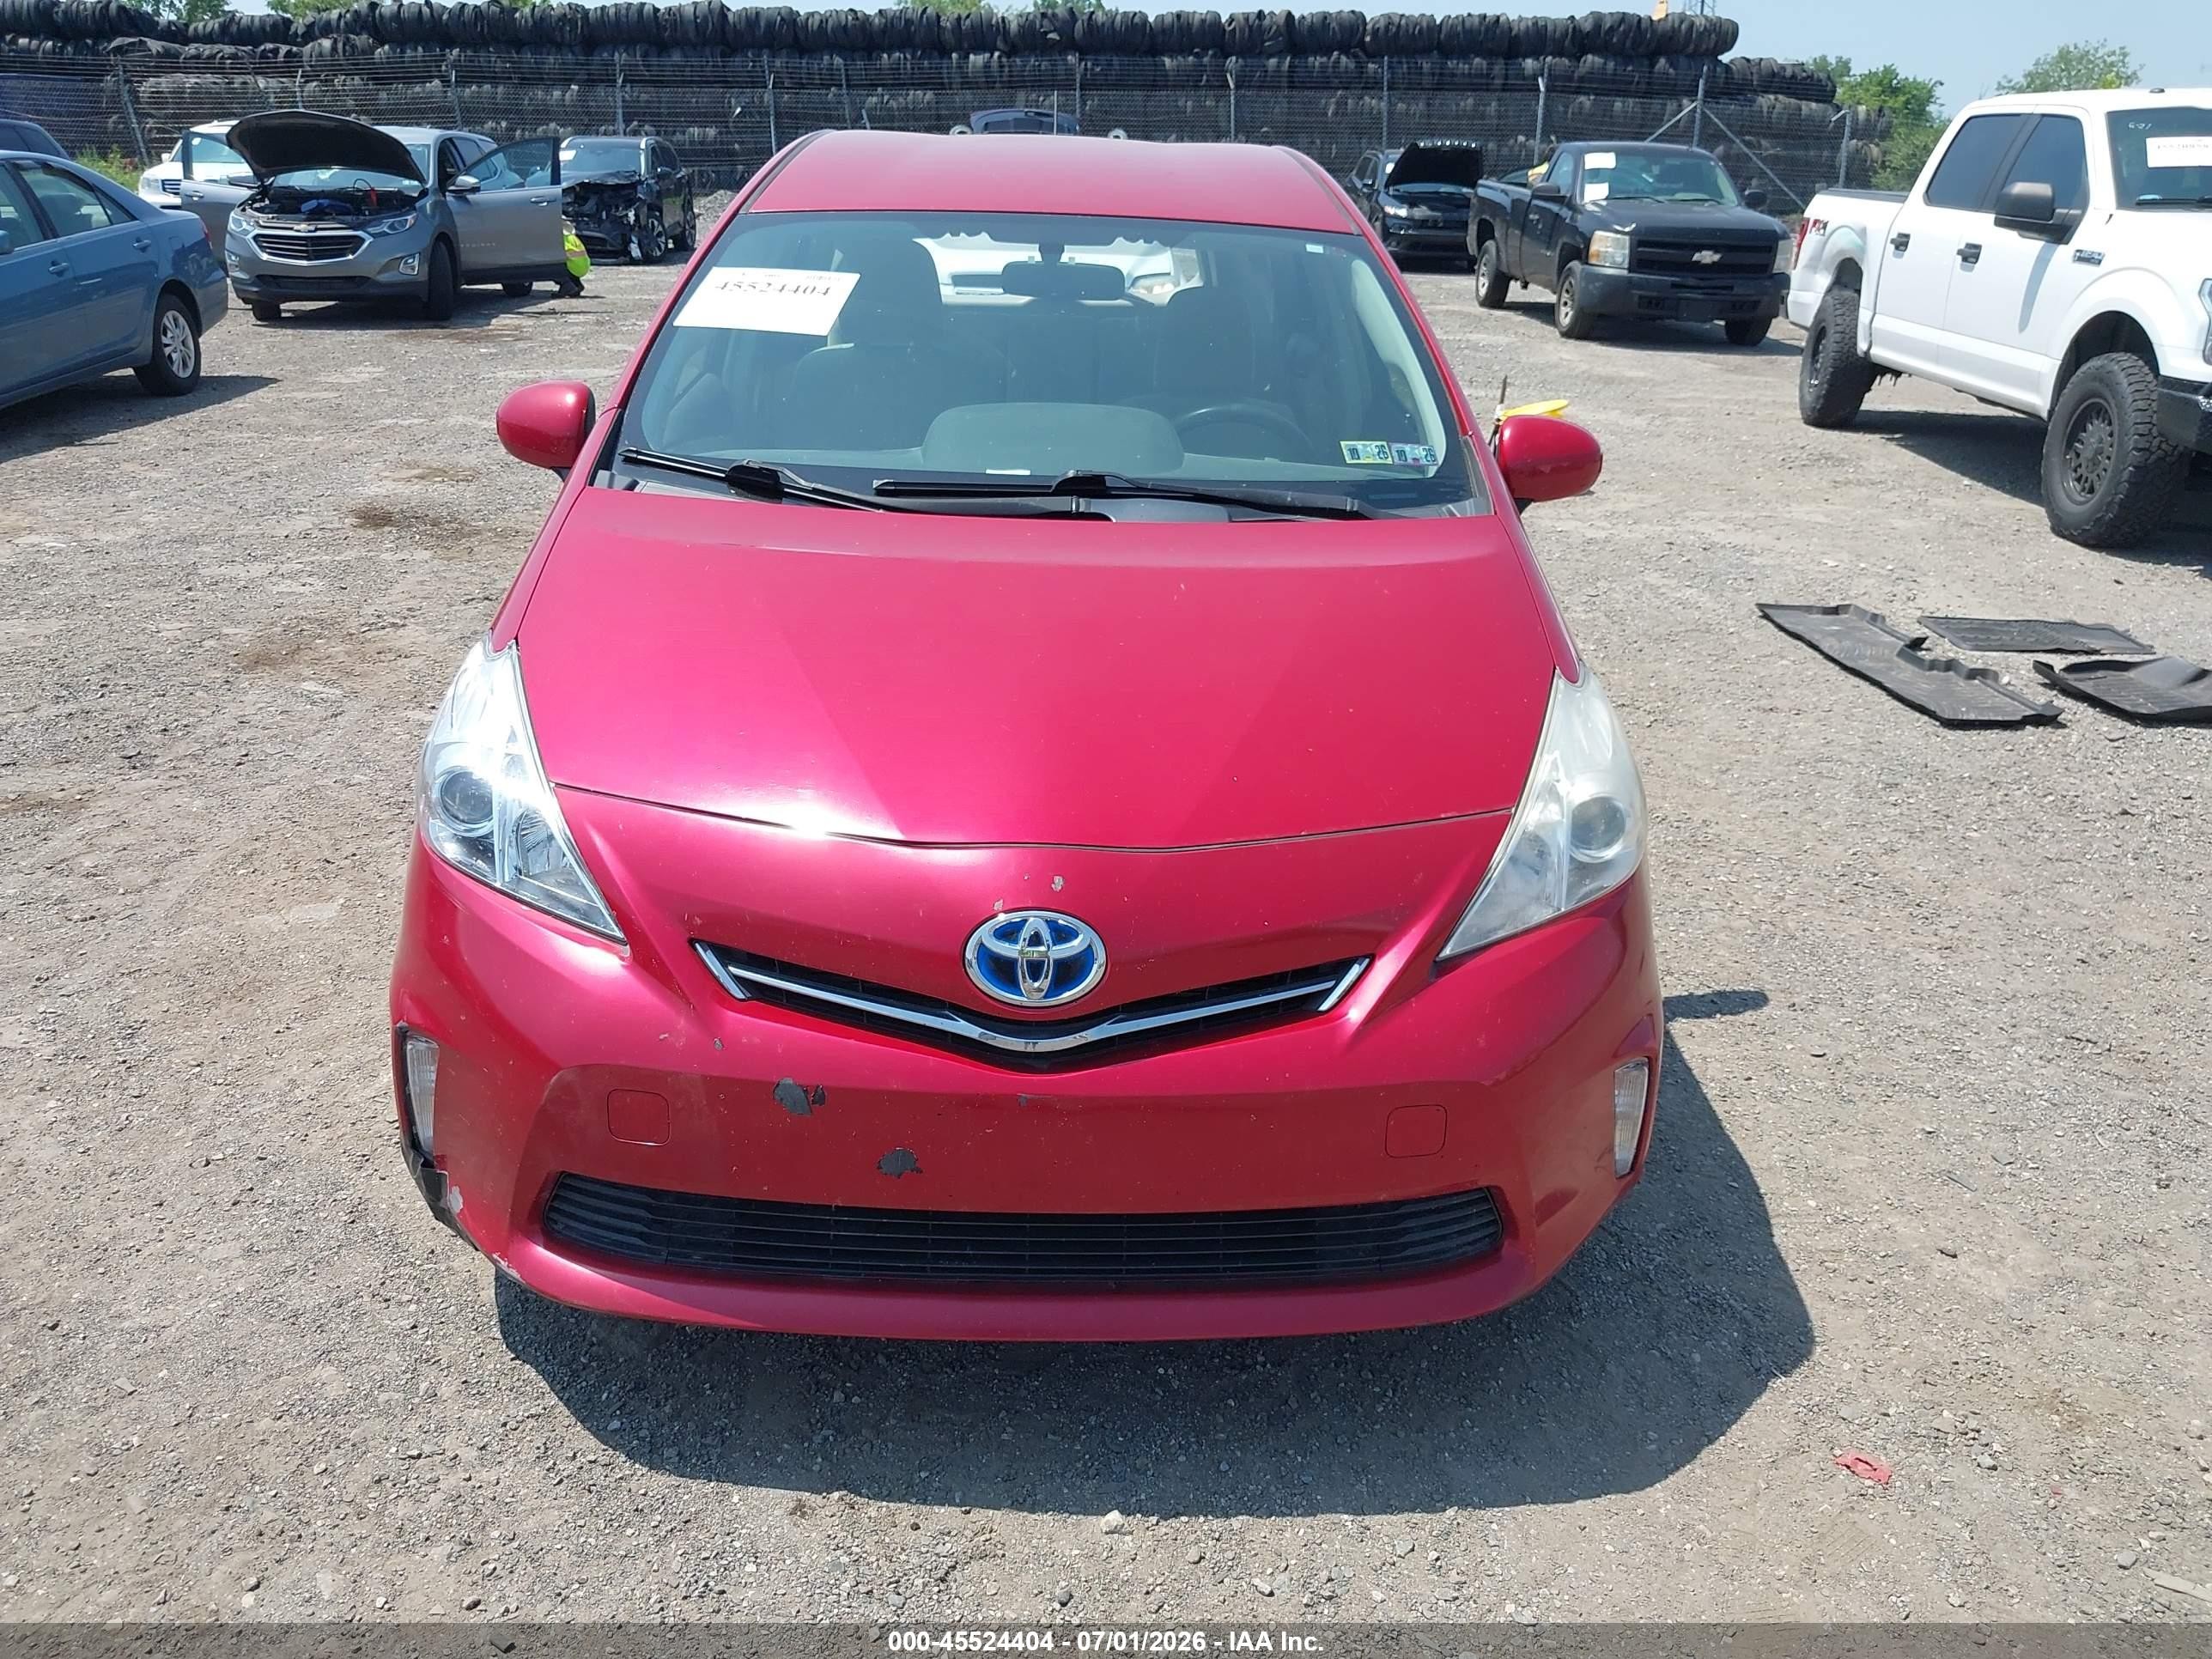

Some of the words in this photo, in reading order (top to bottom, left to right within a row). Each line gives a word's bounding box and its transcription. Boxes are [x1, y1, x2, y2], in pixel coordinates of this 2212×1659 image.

[714, 281, 831, 296] 45524404
[1374, 445, 1389, 460] 26
[1421, 447, 1436, 463] 26
